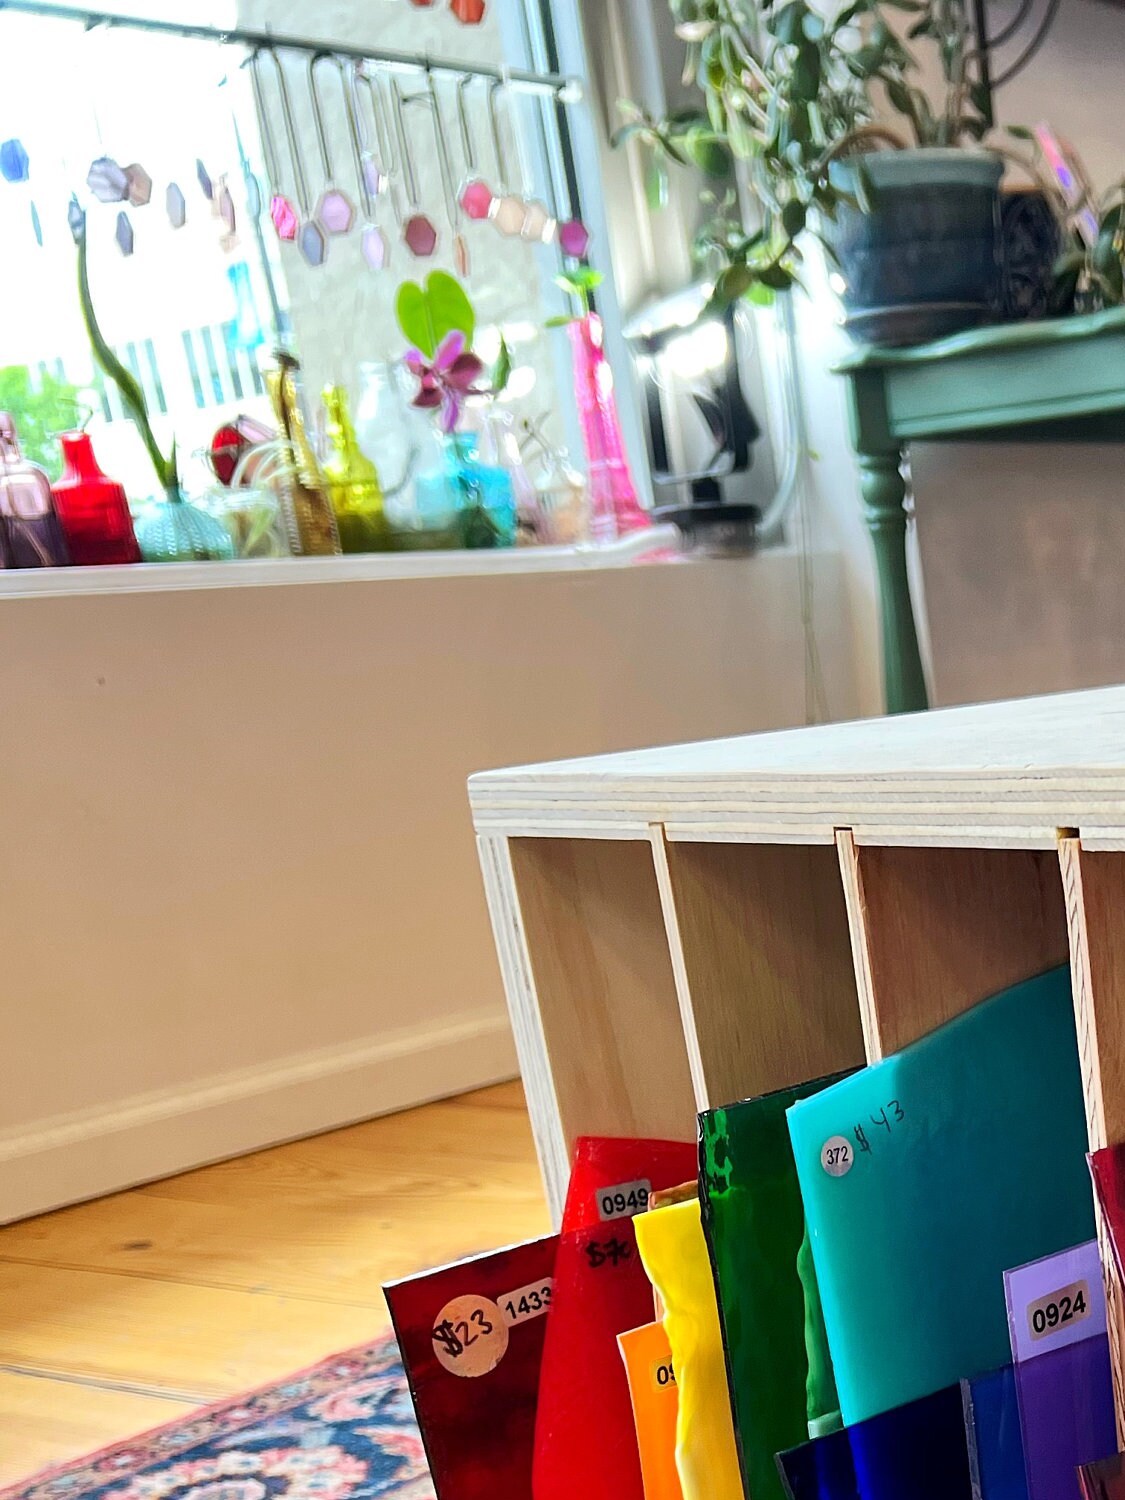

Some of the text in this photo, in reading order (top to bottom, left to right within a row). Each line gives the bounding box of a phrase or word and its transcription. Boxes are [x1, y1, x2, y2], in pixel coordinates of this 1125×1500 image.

[826, 1146, 849, 1165] 372
[602, 1188, 649, 1215] 0949
[505, 1286, 552, 1319] 1433
[1032, 1290, 1087, 1333] 0924
[432, 1309, 493, 1357] $23
